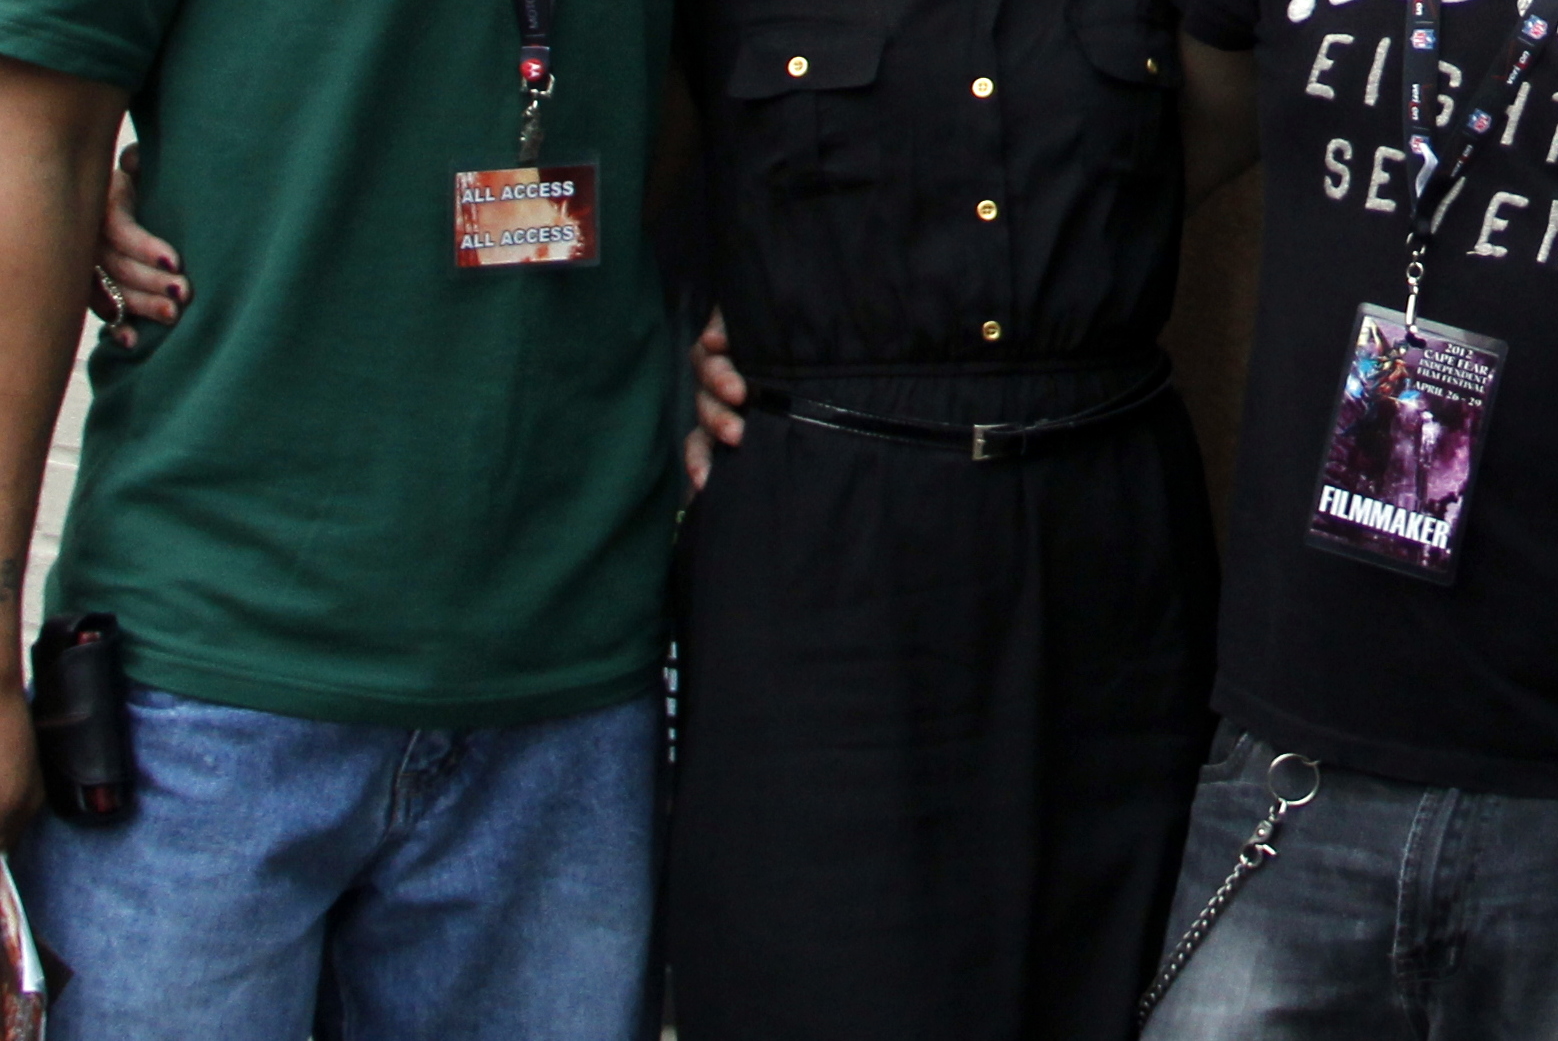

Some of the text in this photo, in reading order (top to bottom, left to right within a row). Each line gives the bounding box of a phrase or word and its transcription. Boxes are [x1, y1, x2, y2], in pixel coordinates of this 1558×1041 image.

[1506, 50, 1532, 85] verizon
[1409, 83, 1422, 121] verizon
[461, 180, 575, 204] ALL ACCESS
[460, 224, 575, 250] ALL ACCESS
[1424, 349, 1489, 375] CAPE FEAR
[1445, 343, 1473, 359] 2012
[1417, 366, 1485, 394] FILM FESTIVAL
[1419, 358, 1487, 384] INDEPENDENT
[1413, 381, 1443, 397] APRIL
[1446, 390, 1459, 401] 26
[1468, 396, 1482, 407] 29
[1318, 484, 1451, 550] FILMMAKER
